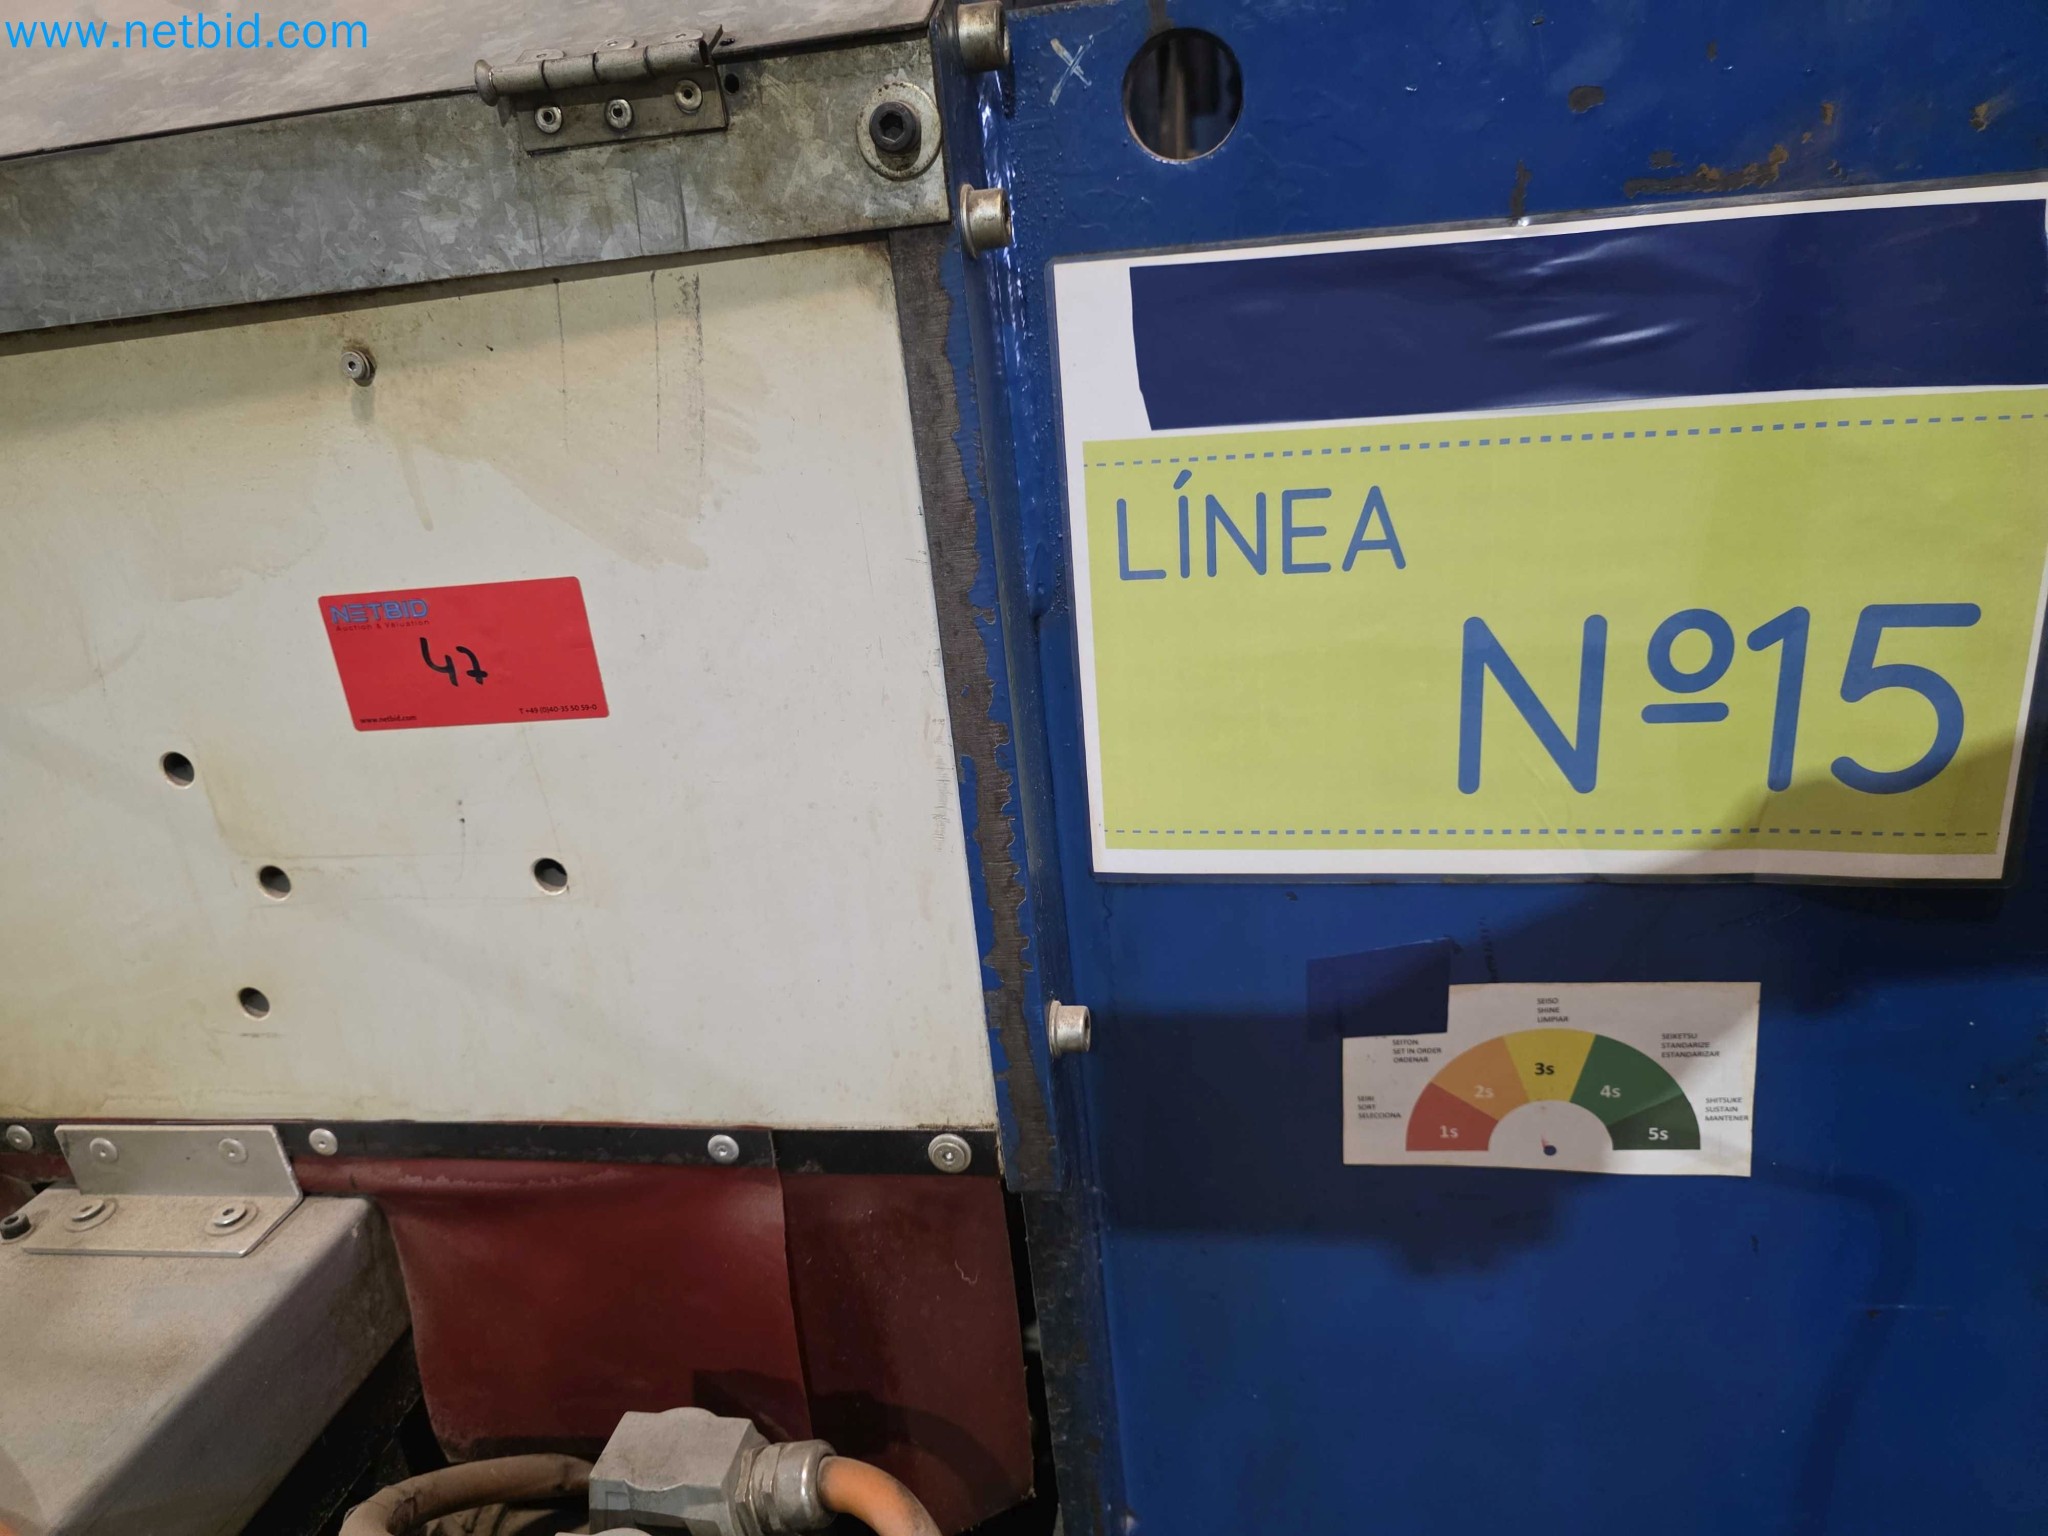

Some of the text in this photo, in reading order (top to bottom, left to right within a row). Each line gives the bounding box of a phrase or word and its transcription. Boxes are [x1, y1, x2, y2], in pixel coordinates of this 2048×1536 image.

[1116, 469, 1407, 581] LÍNEA
[330, 598, 428, 624] NETBID
[335, 624, 373, 632] Auction
[384, 619, 430, 629] Valuation
[419, 636, 488, 687] 47
[359, 714, 417, 723] www.netbid.com
[1536, 1006, 1560, 1014] SHINE
[1536, 1015, 1569, 1024] LIMPIAR
[1661, 1032, 1698, 1040] SEIKETSU
[1416, 1046, 1442, 1054] ORDER
[1661, 1050, 1720, 1058] ESTANDARIZAR
[1393, 1056, 1429, 1064] ORDENAR
[1534, 1062, 1555, 1076] 3s
[1474, 1085, 1494, 1099] 2s
[1600, 1085, 1621, 1098] 4s
[1705, 1096, 1743, 1104] SHITSUKE
[1705, 1105, 1739, 1113] SUSTAIN
[1705, 1114, 1749, 1122] MANTENER
[1440, 1125, 1459, 1138] 1s
[1648, 1127, 1669, 1141] 5s
